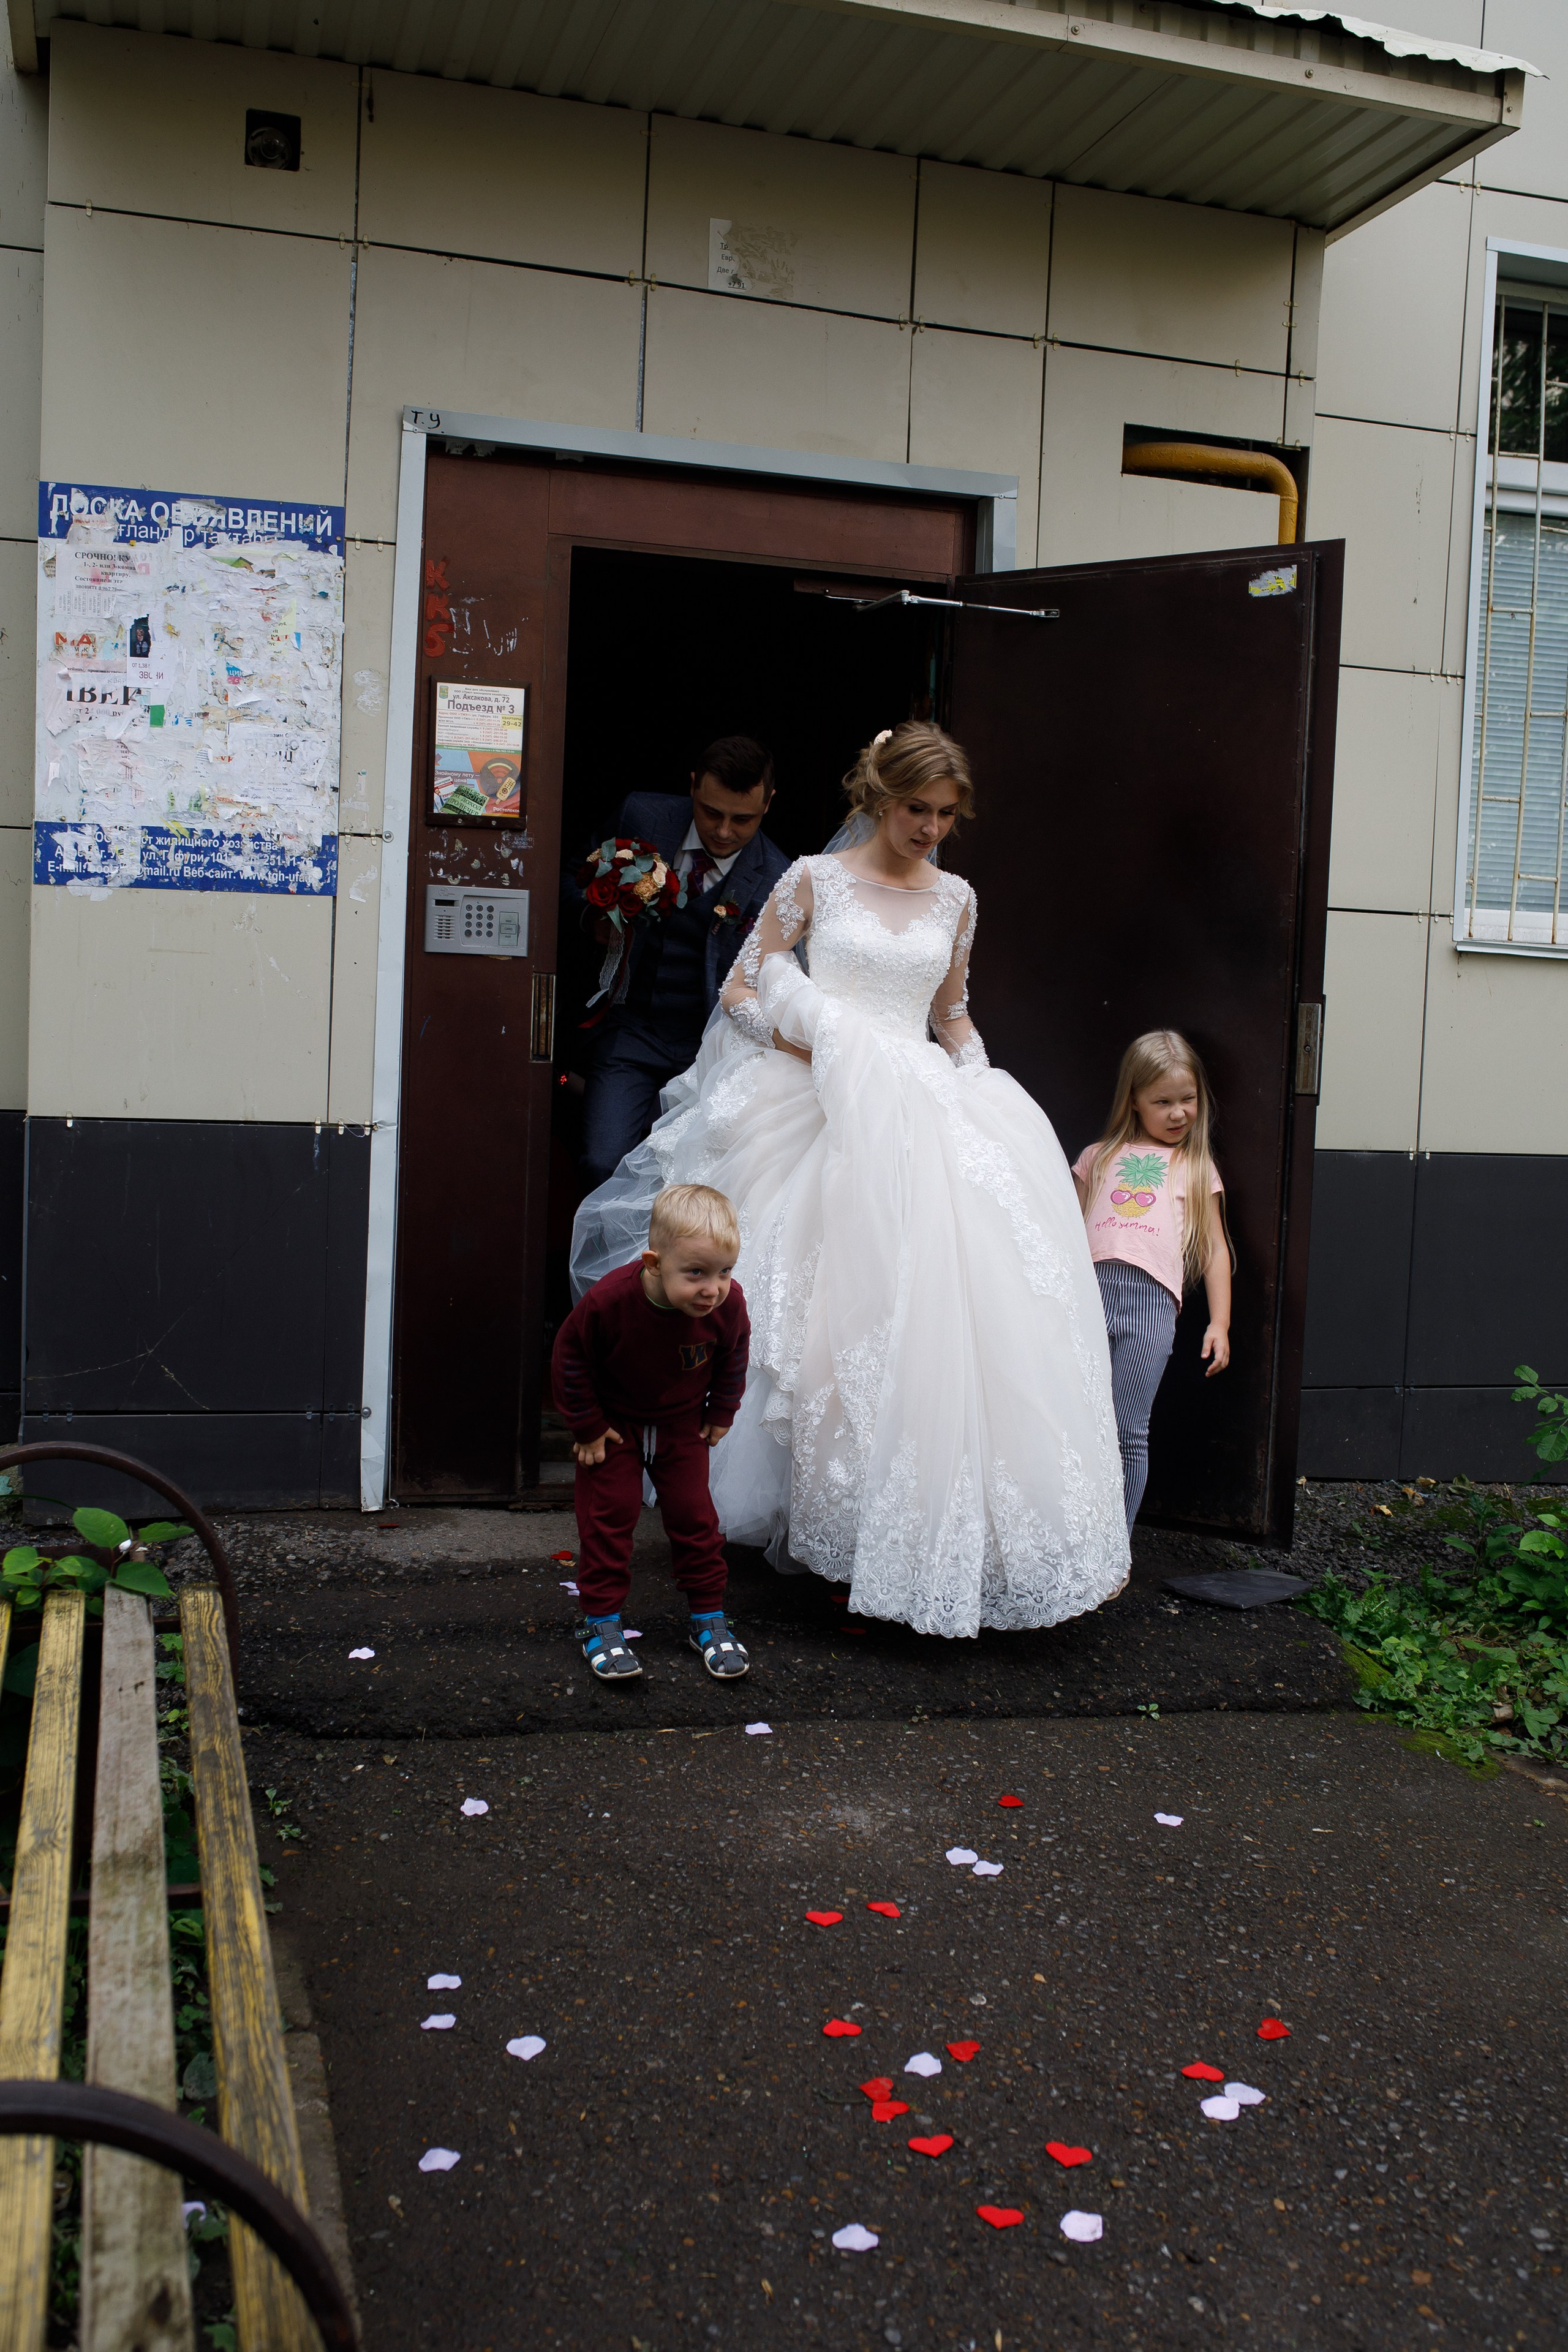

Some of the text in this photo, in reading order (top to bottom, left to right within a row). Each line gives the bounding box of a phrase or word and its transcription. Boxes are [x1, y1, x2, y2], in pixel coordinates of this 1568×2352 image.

[75, 552, 116, 561] СРОЧНО!
[462, 694, 492, 703] Аксакова,
[448, 699, 494, 713] Подъезд
[508, 705, 514, 714] 3
[462, 797, 482, 810] ДОХОД
[155, 837, 219, 848] жилищного
[143, 851, 159, 864] ул.
[1095, 1217, 1117, 1232] Hello
